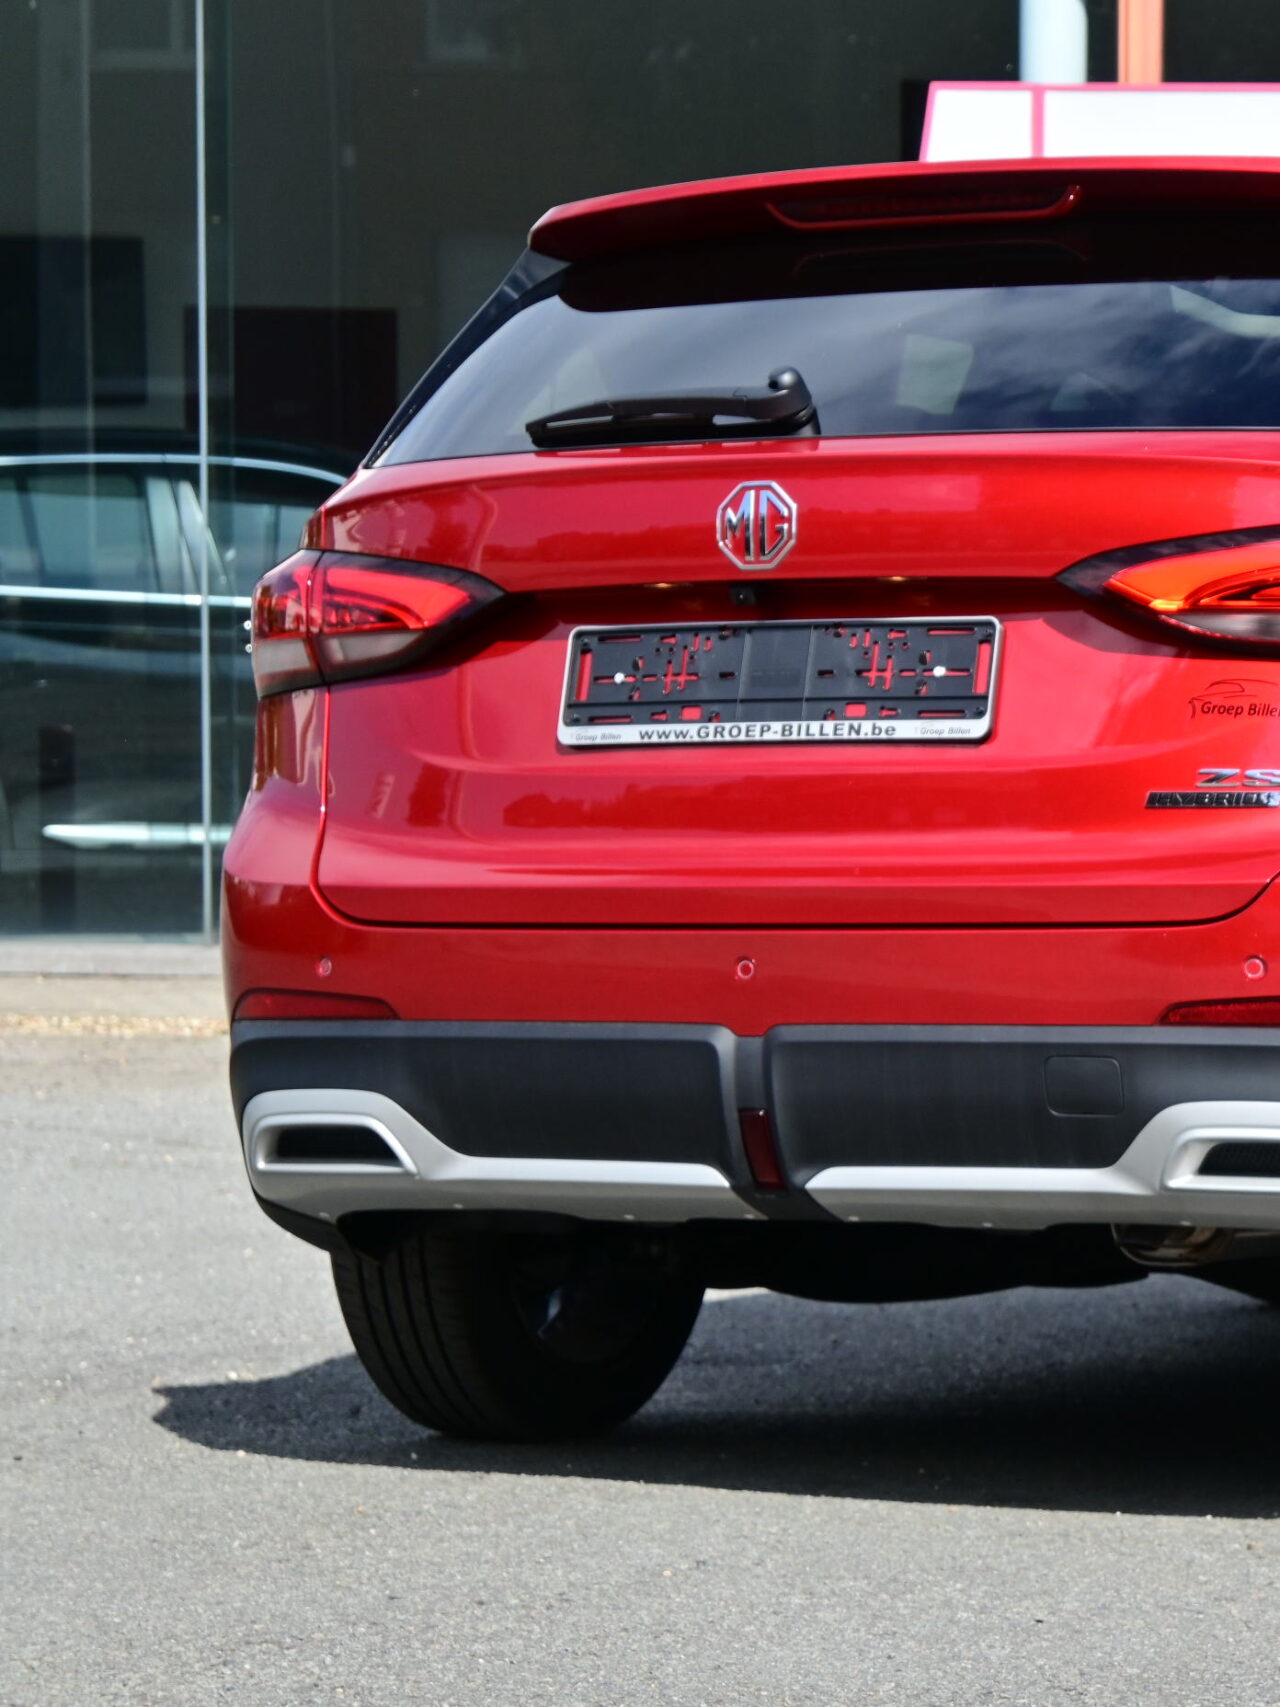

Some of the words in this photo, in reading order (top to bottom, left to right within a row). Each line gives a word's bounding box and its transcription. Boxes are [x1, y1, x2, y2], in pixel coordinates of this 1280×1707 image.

[726, 490, 788, 560] MG
[1201, 701, 1244, 718] Groep
[639, 722, 896, 740] www.GROEP-BILLEN.be
[920, 725, 944, 736] Groep
[947, 725, 971, 735] Billen
